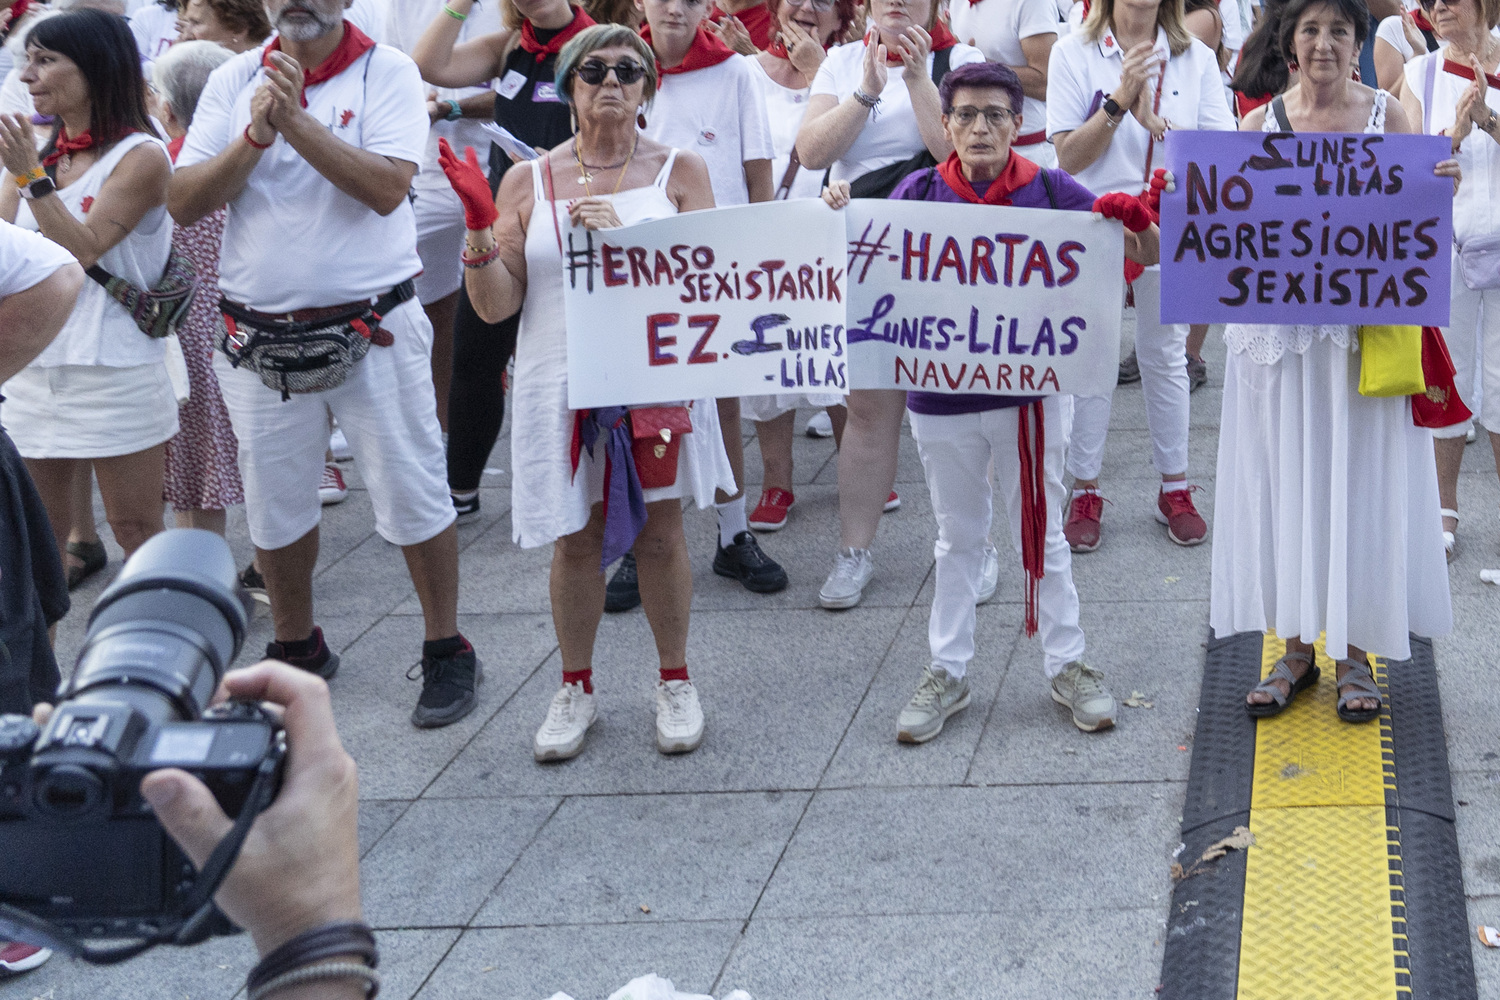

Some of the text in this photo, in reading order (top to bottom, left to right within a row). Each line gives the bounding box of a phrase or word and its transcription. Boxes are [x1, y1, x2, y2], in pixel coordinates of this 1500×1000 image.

[1185, 161, 1254, 216] NO
[565, 230, 715, 295] #ERASO
[895, 355, 1061, 392] NAVARRA
